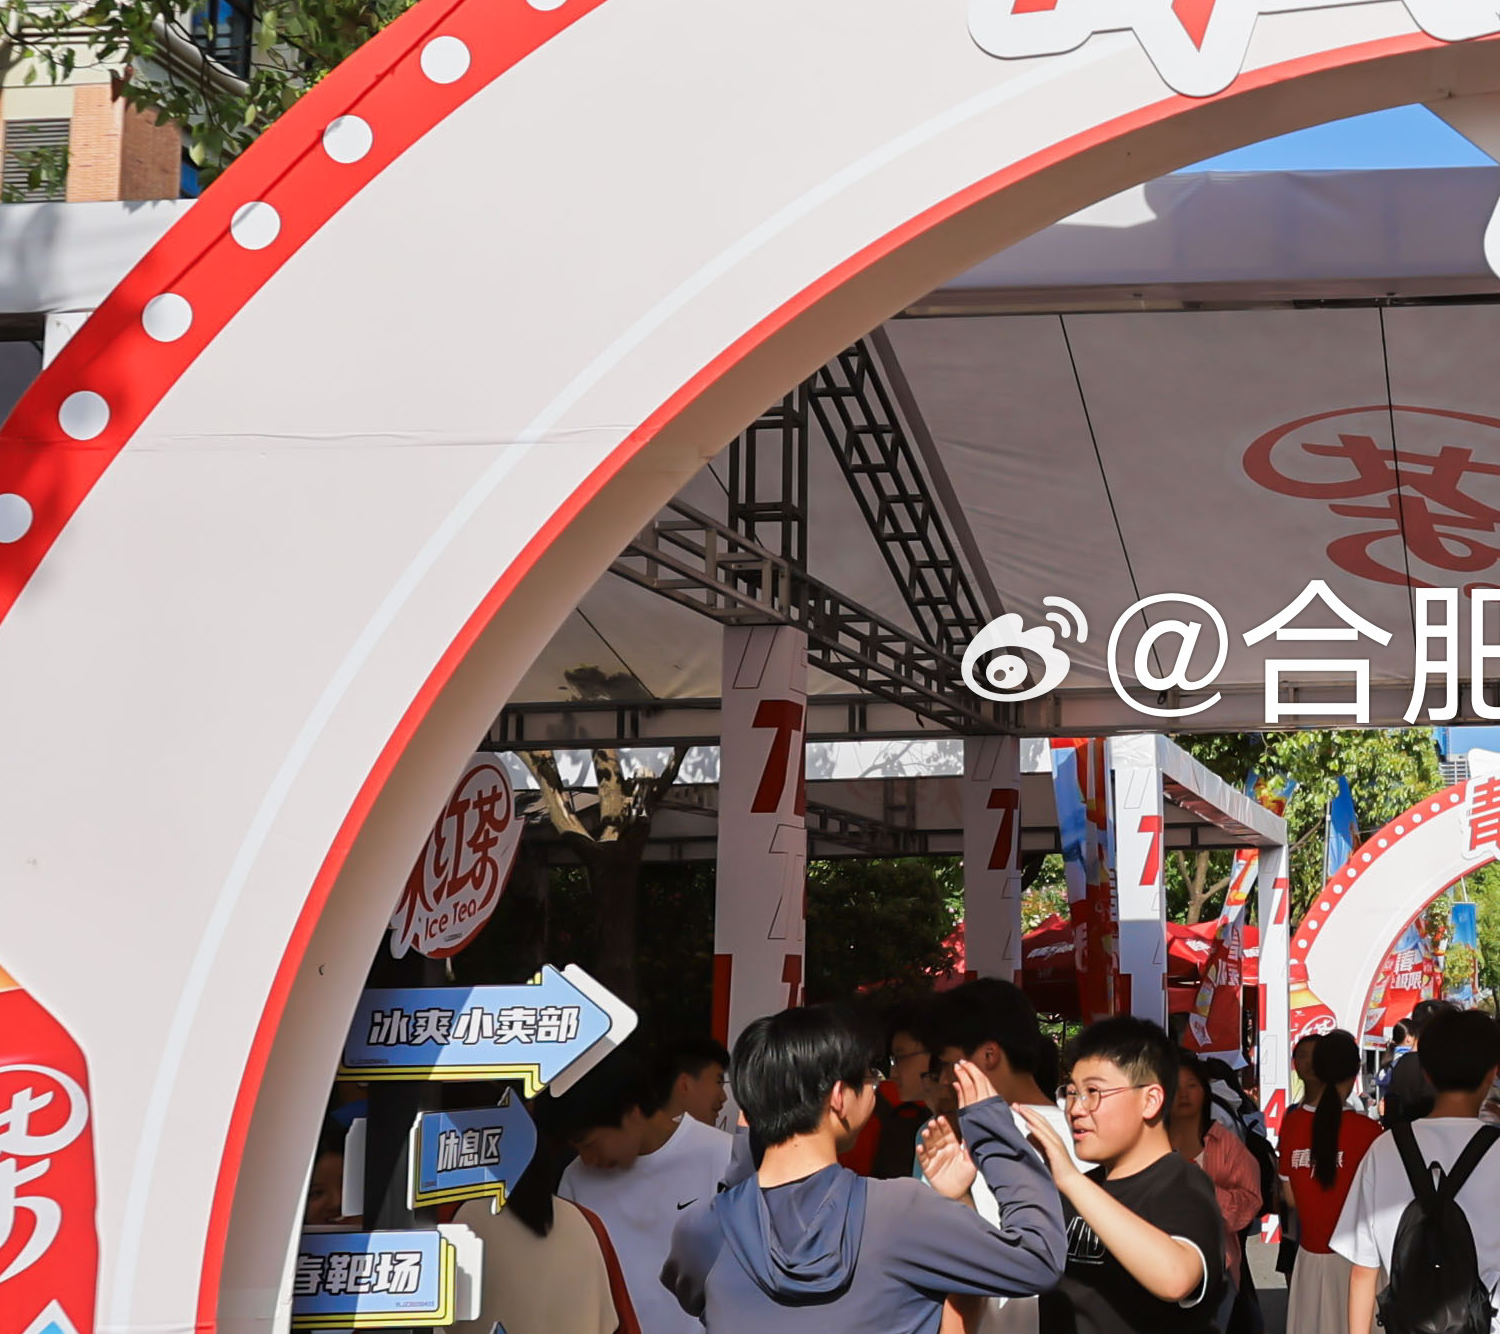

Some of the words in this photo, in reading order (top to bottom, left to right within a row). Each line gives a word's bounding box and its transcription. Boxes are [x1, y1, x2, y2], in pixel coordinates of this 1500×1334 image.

[424, 915, 450, 942] Ice
[452, 898, 478, 926] Tea
[368, 1005, 583, 1046] 冰爽小卖部
[436, 1127, 502, 1174] 休息区
